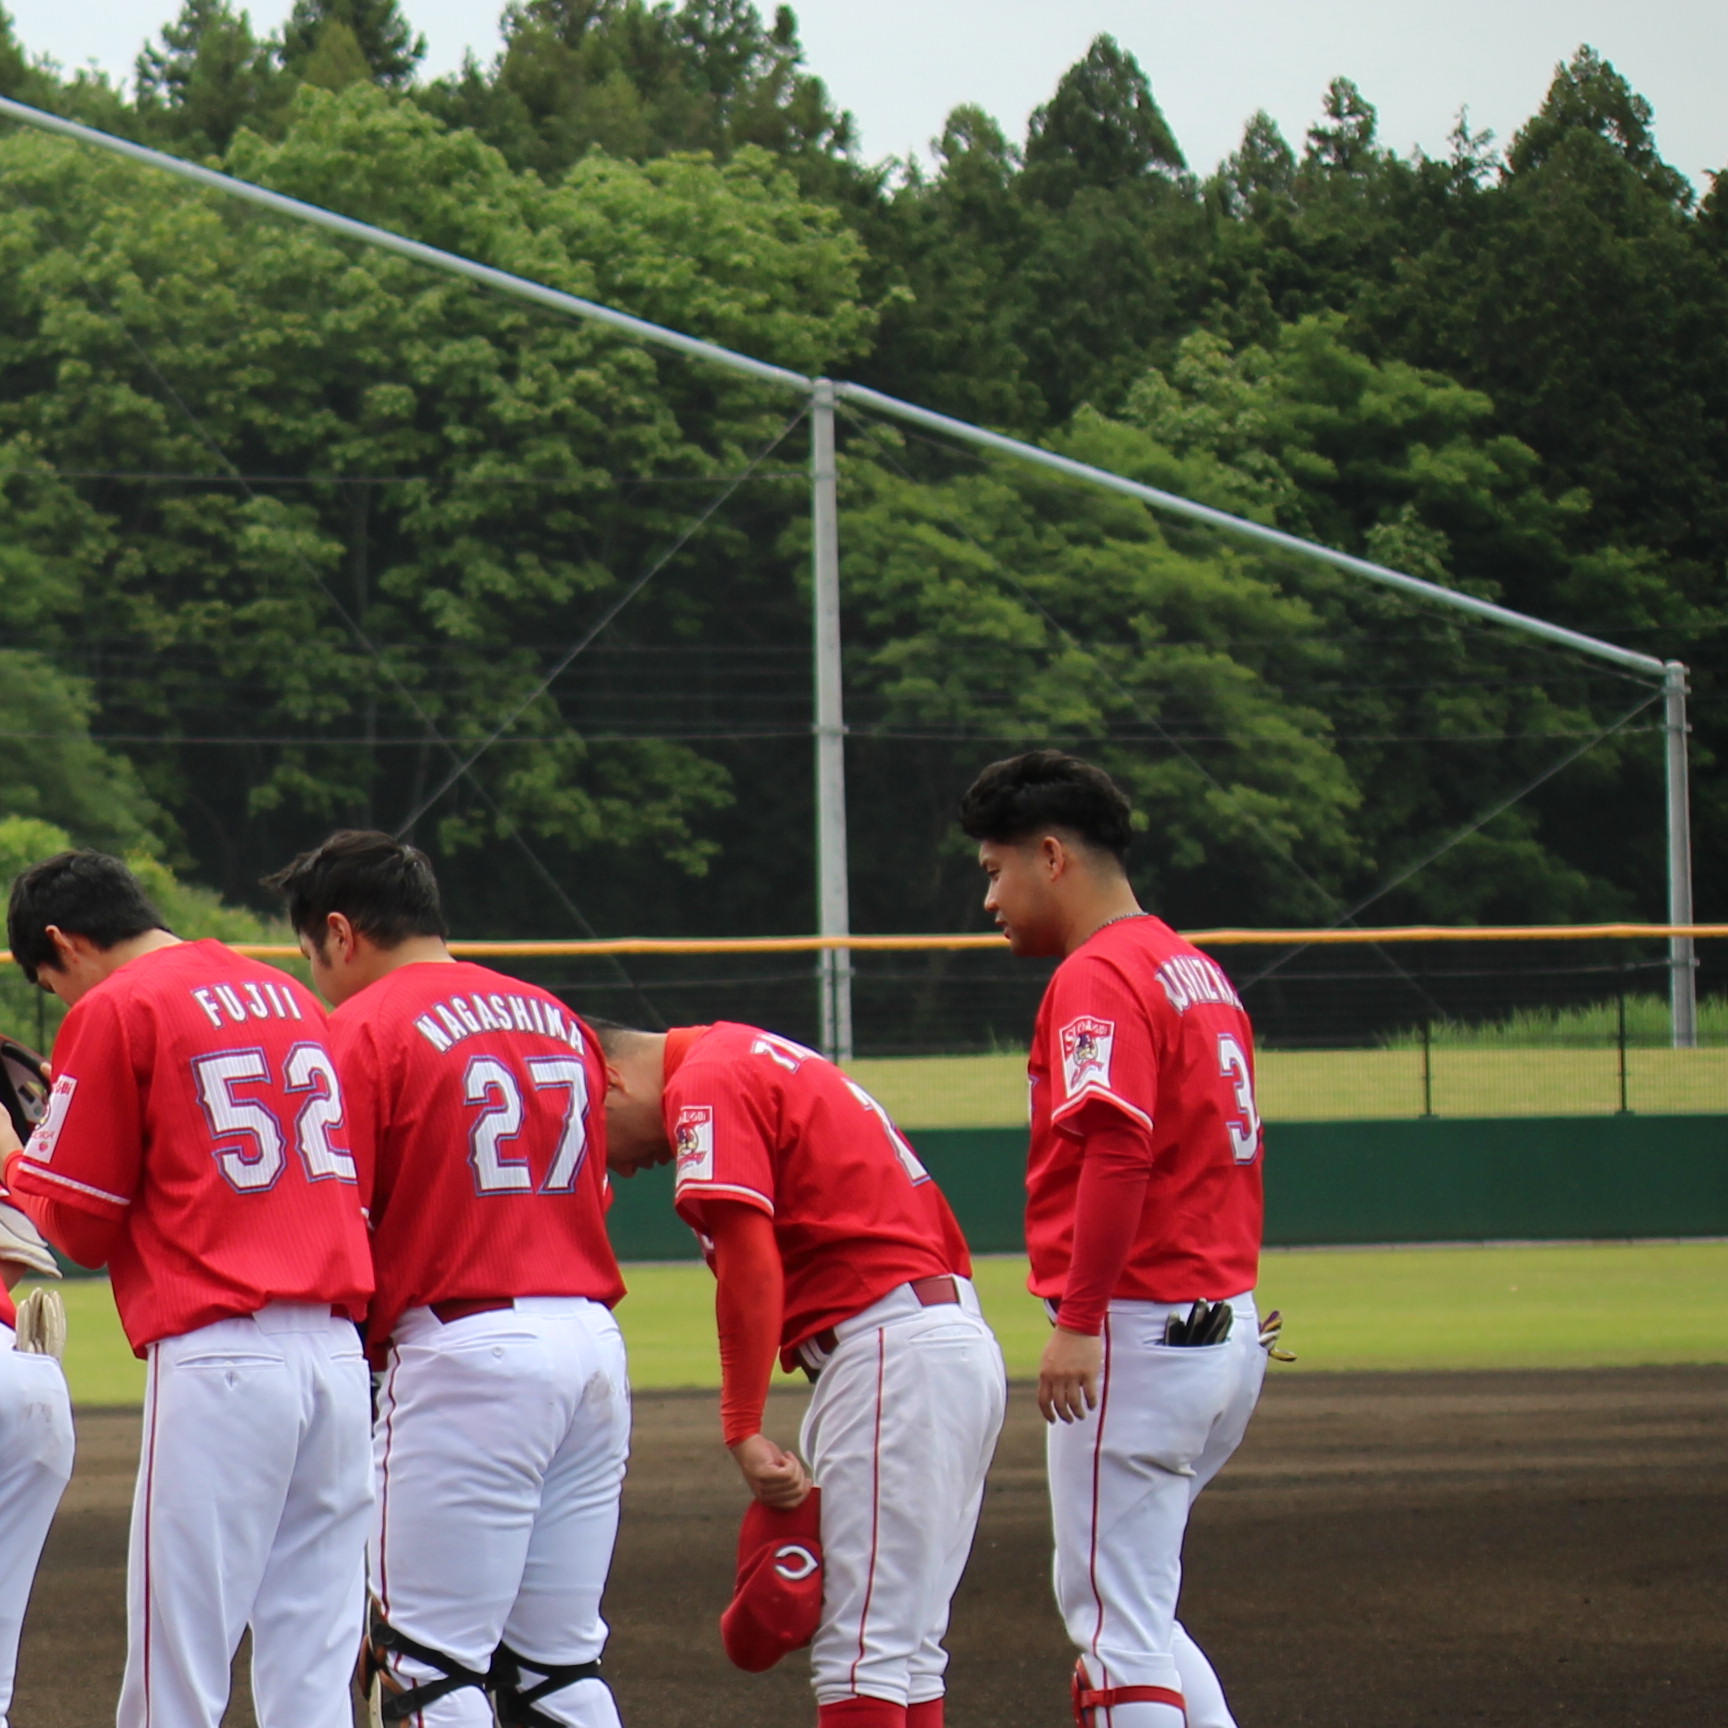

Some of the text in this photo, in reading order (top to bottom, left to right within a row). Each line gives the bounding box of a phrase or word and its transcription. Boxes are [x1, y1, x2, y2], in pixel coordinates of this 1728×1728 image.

[191, 983, 303, 1030] FUJII
[414, 993, 586, 1056] NAGASHIMA
[190, 1041, 360, 1195] 52
[463, 1054, 590, 1197] 27
